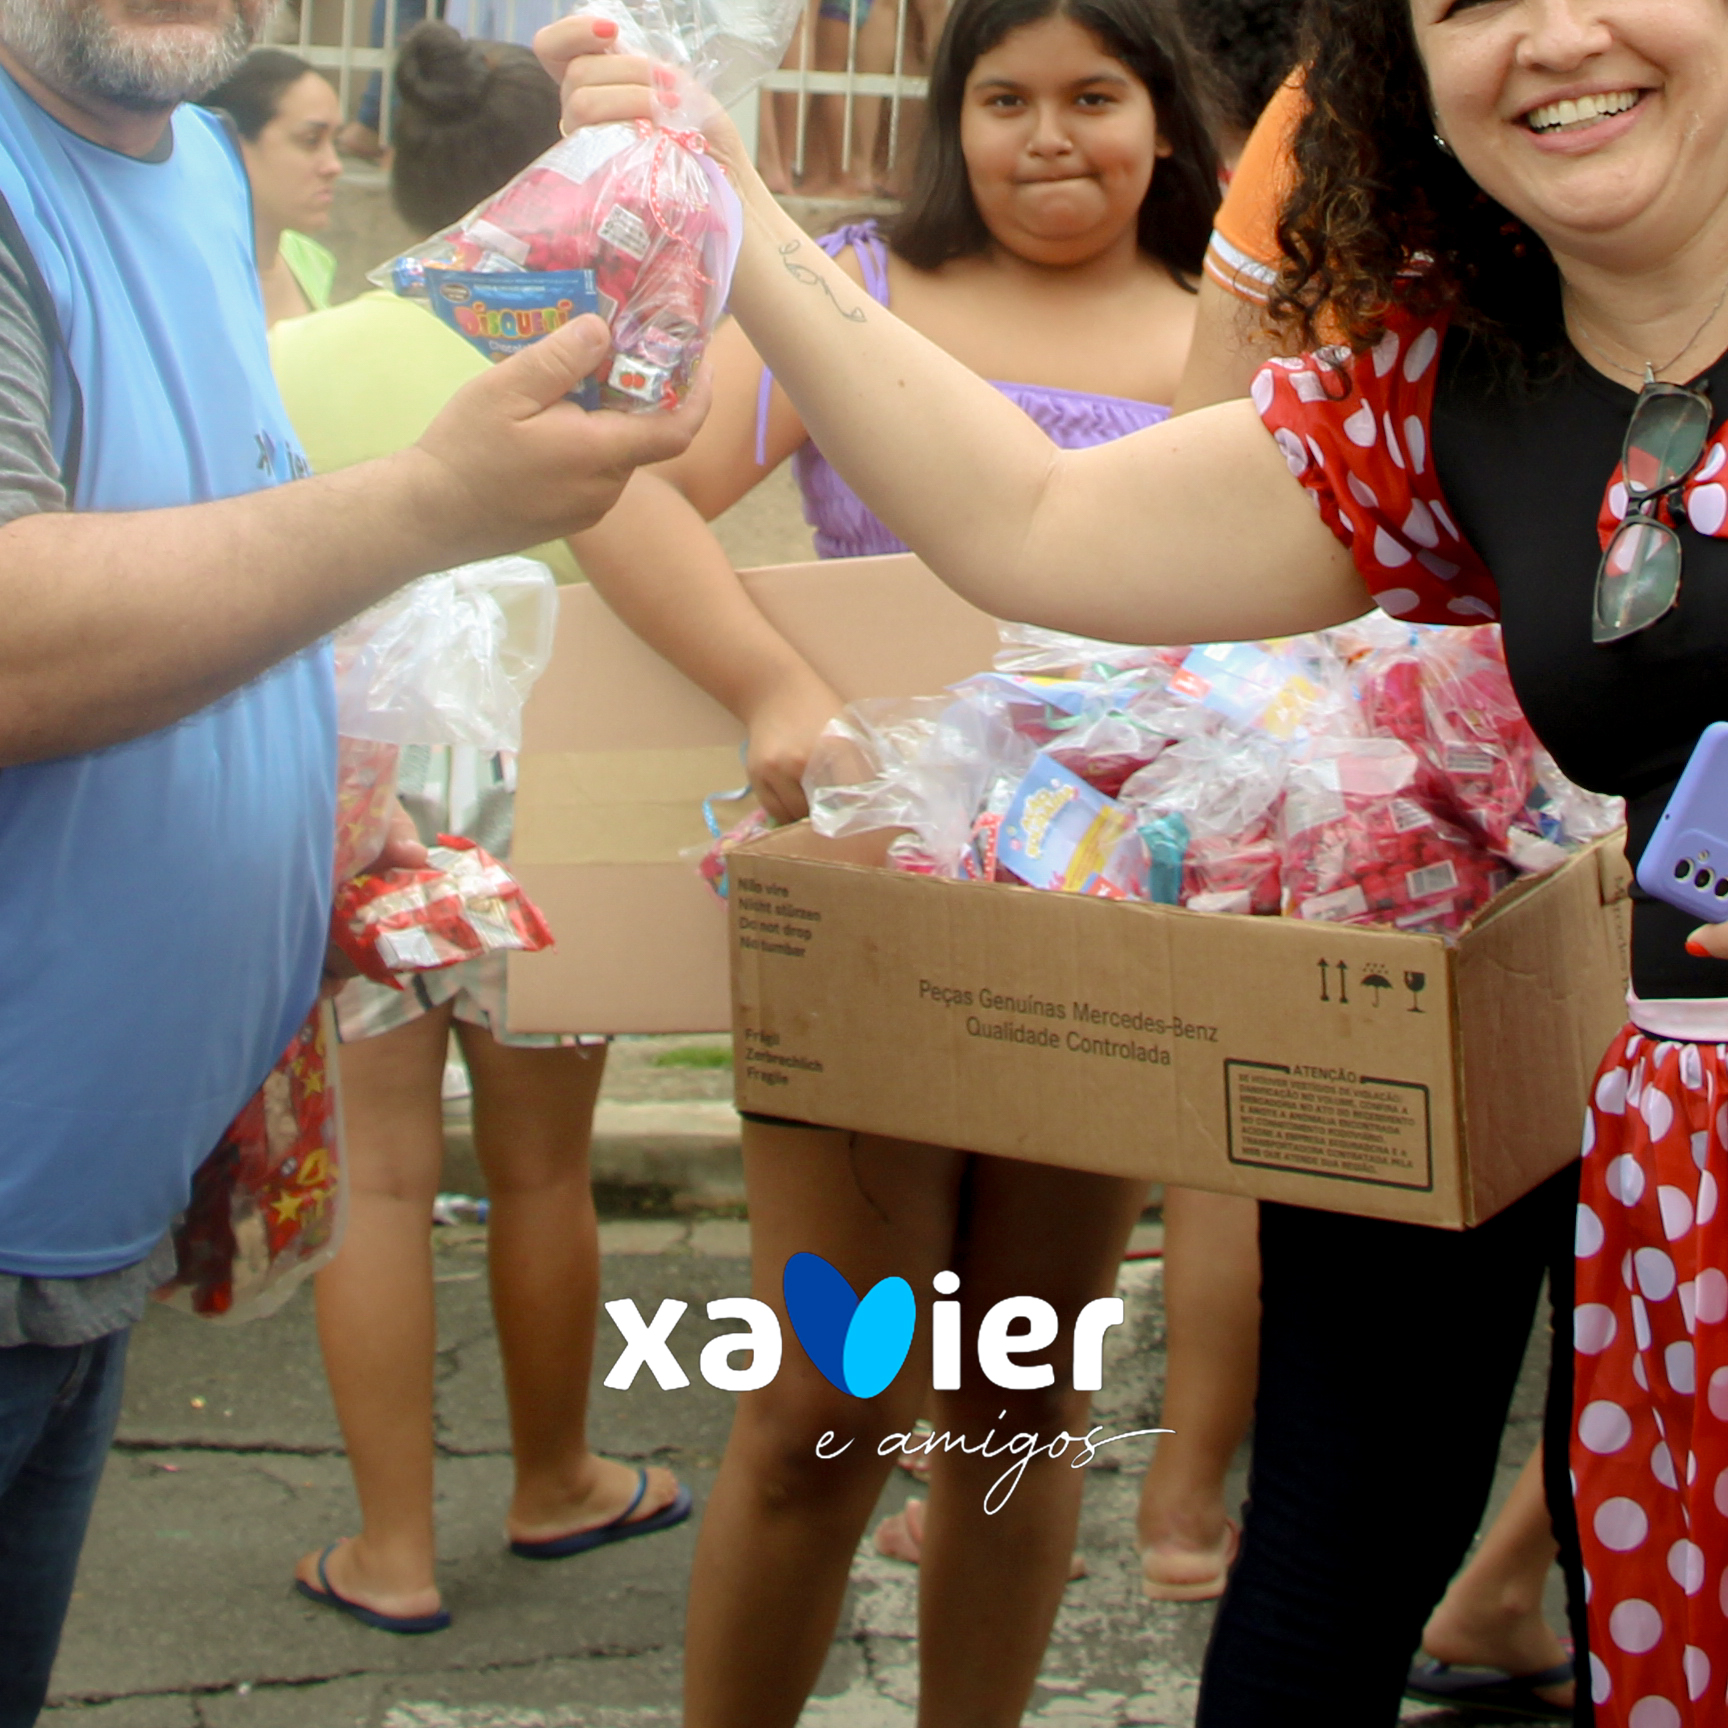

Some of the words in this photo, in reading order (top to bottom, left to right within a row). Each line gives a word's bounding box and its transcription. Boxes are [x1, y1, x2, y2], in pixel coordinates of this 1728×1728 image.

[739, 898, 772, 913] Nicht
[759, 922, 780, 934] not
[783, 924, 812, 941] drop
[918, 979, 974, 1008] Peças
[979, 988, 1066, 1019] Genuínas
[1072, 1001, 1219, 1043] Mercedes-Benz
[966, 1016, 1060, 1048] Qualidade
[1066, 1031, 1171, 1066] Controlada
[747, 1066, 789, 1086] Fragile
[1294, 1064, 1357, 1084] ATENÇÃO
